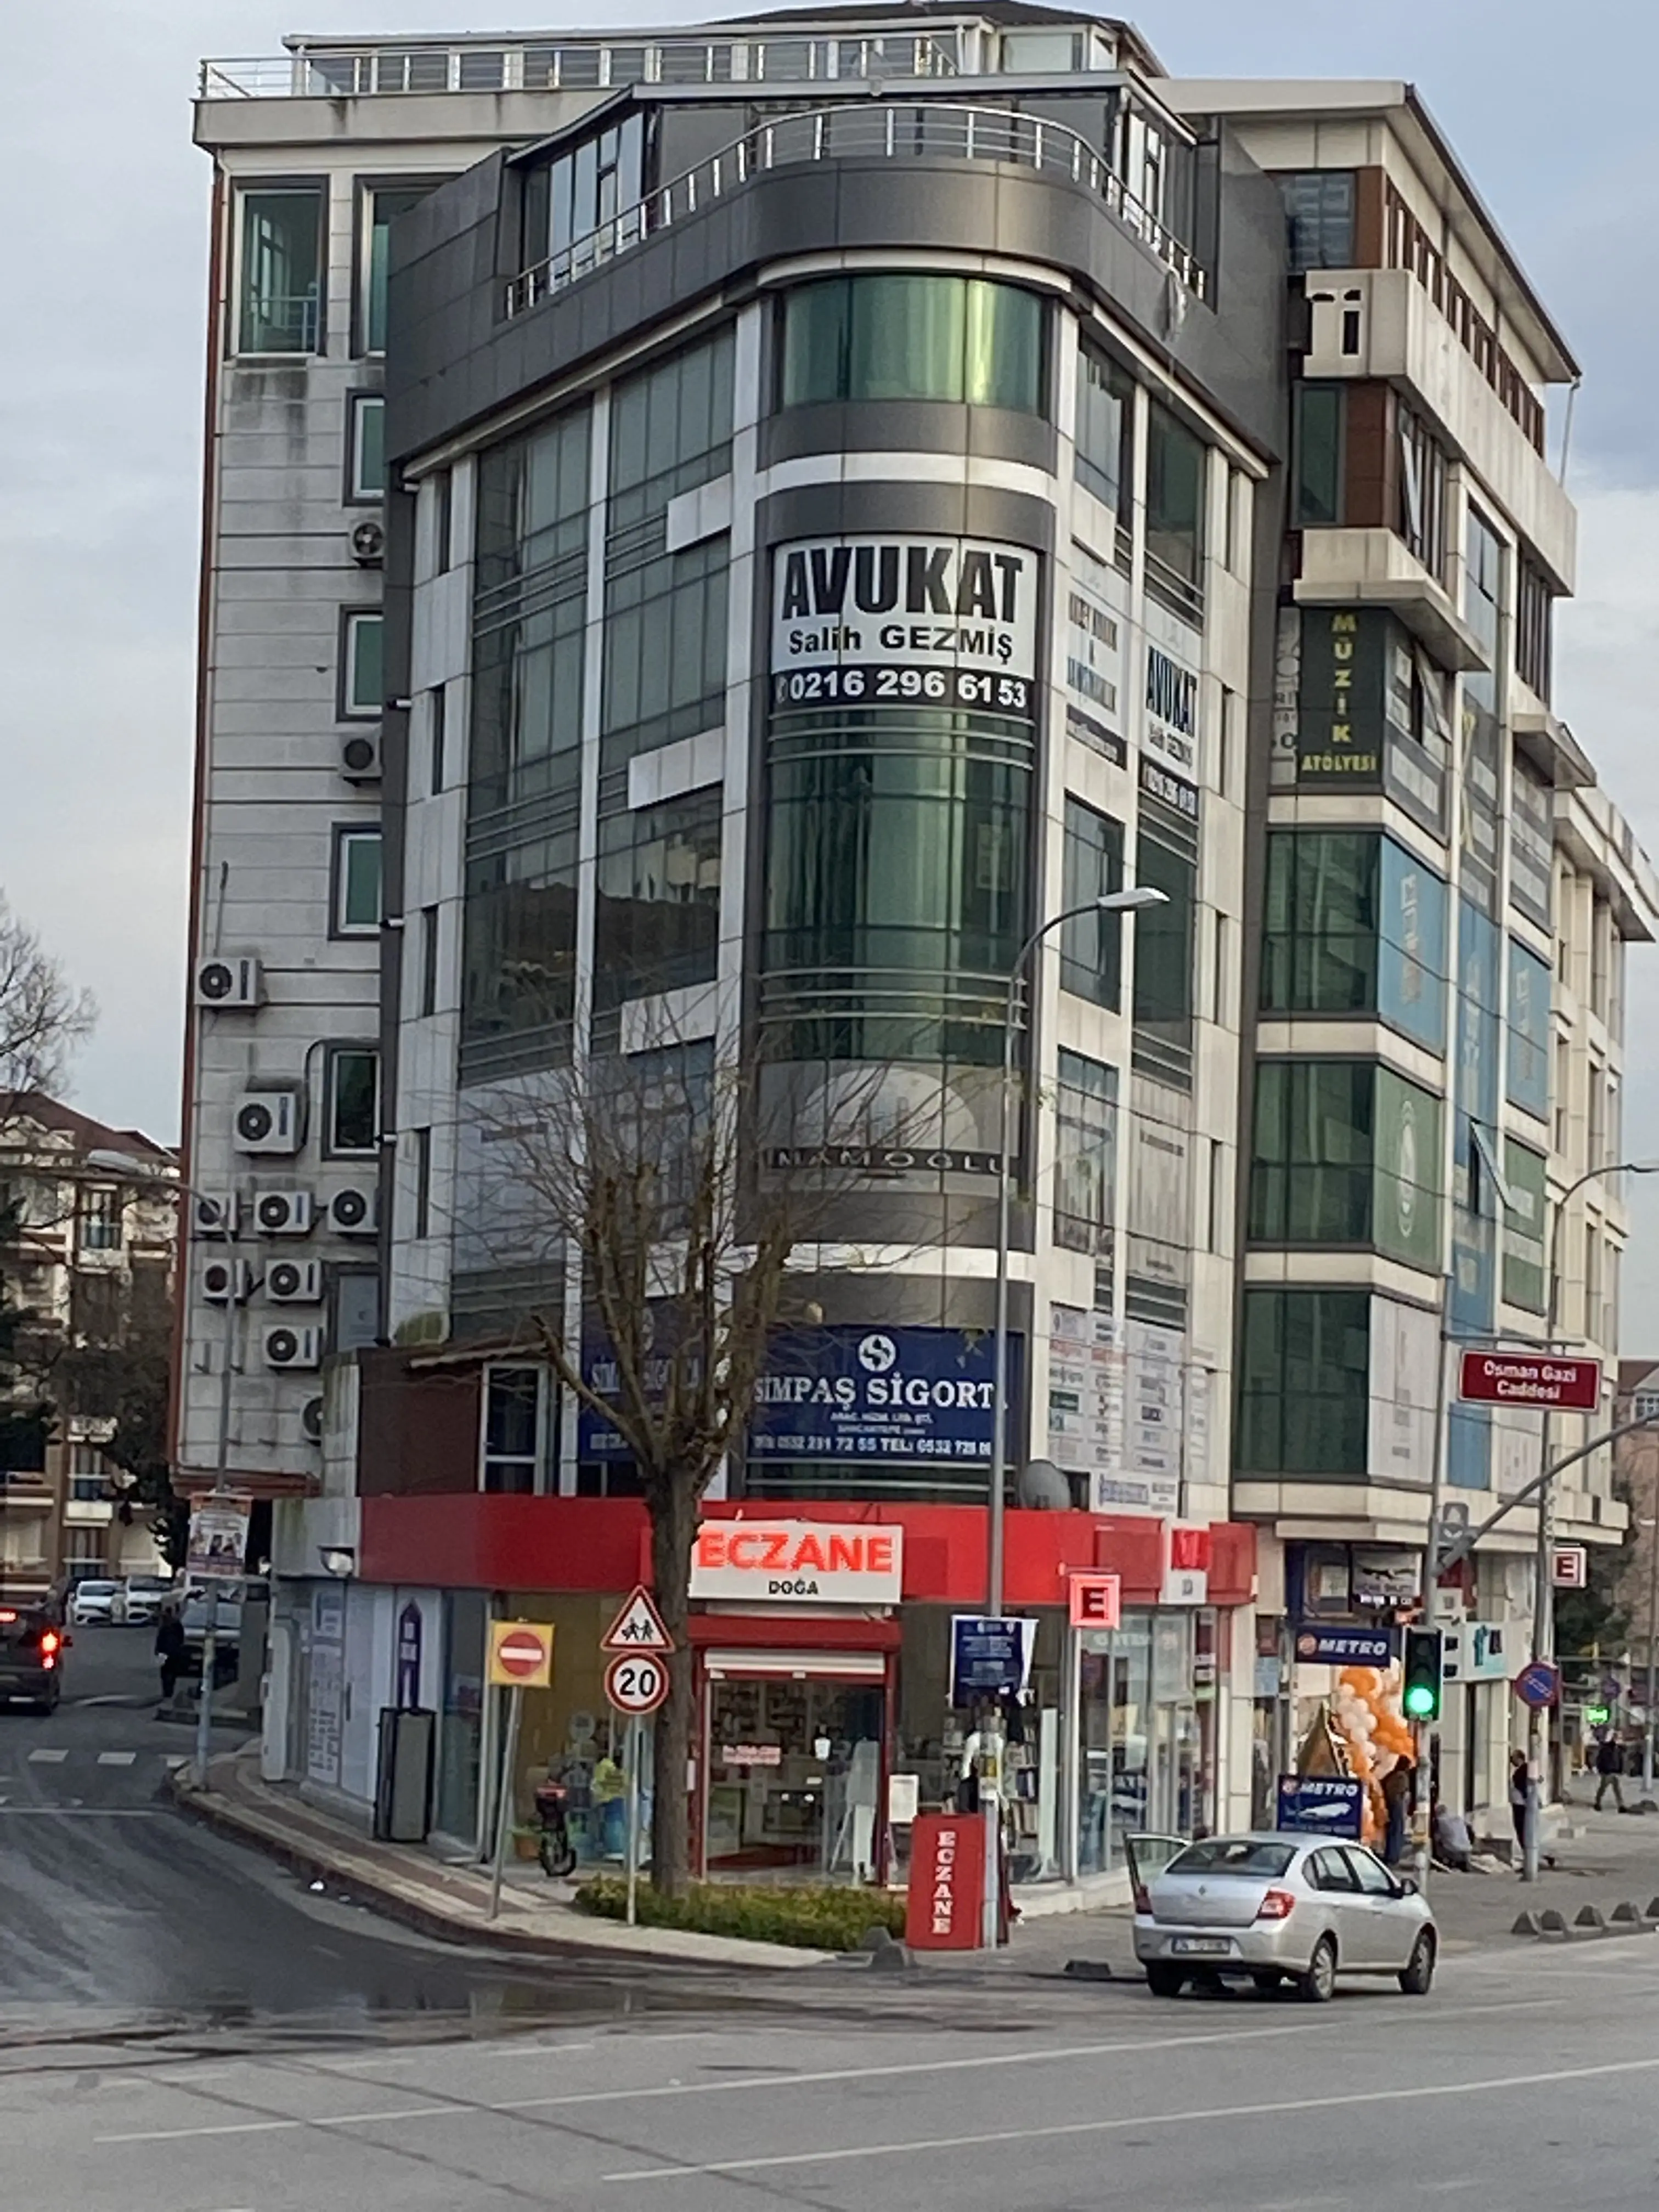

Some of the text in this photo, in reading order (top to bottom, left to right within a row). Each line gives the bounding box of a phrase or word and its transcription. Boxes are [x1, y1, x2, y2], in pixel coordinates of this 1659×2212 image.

[781, 546, 1023, 623] AVUKAT
[788, 623, 1013, 665] Salih GEZMİŞ
[789, 669, 1026, 708] 0216 296 61 53
[1483, 1360, 1577, 1382] Osman Gazi
[754, 1371, 1008, 1410] SİMPAŞ SİGORT
[1497, 1379, 1561, 1399] Caddesi
[697, 1530, 893, 1573] ECZANE
[1556, 1556, 1574, 1579] E
[768, 1578, 819, 1596] DOĞA
[1081, 1587, 1105, 1620] E
[1318, 1638, 1387, 1656] METRO
[619, 1668, 657, 1695] 20
[1299, 1782, 1359, 1797] METRO
[932, 1831, 956, 1934] ECZANE
